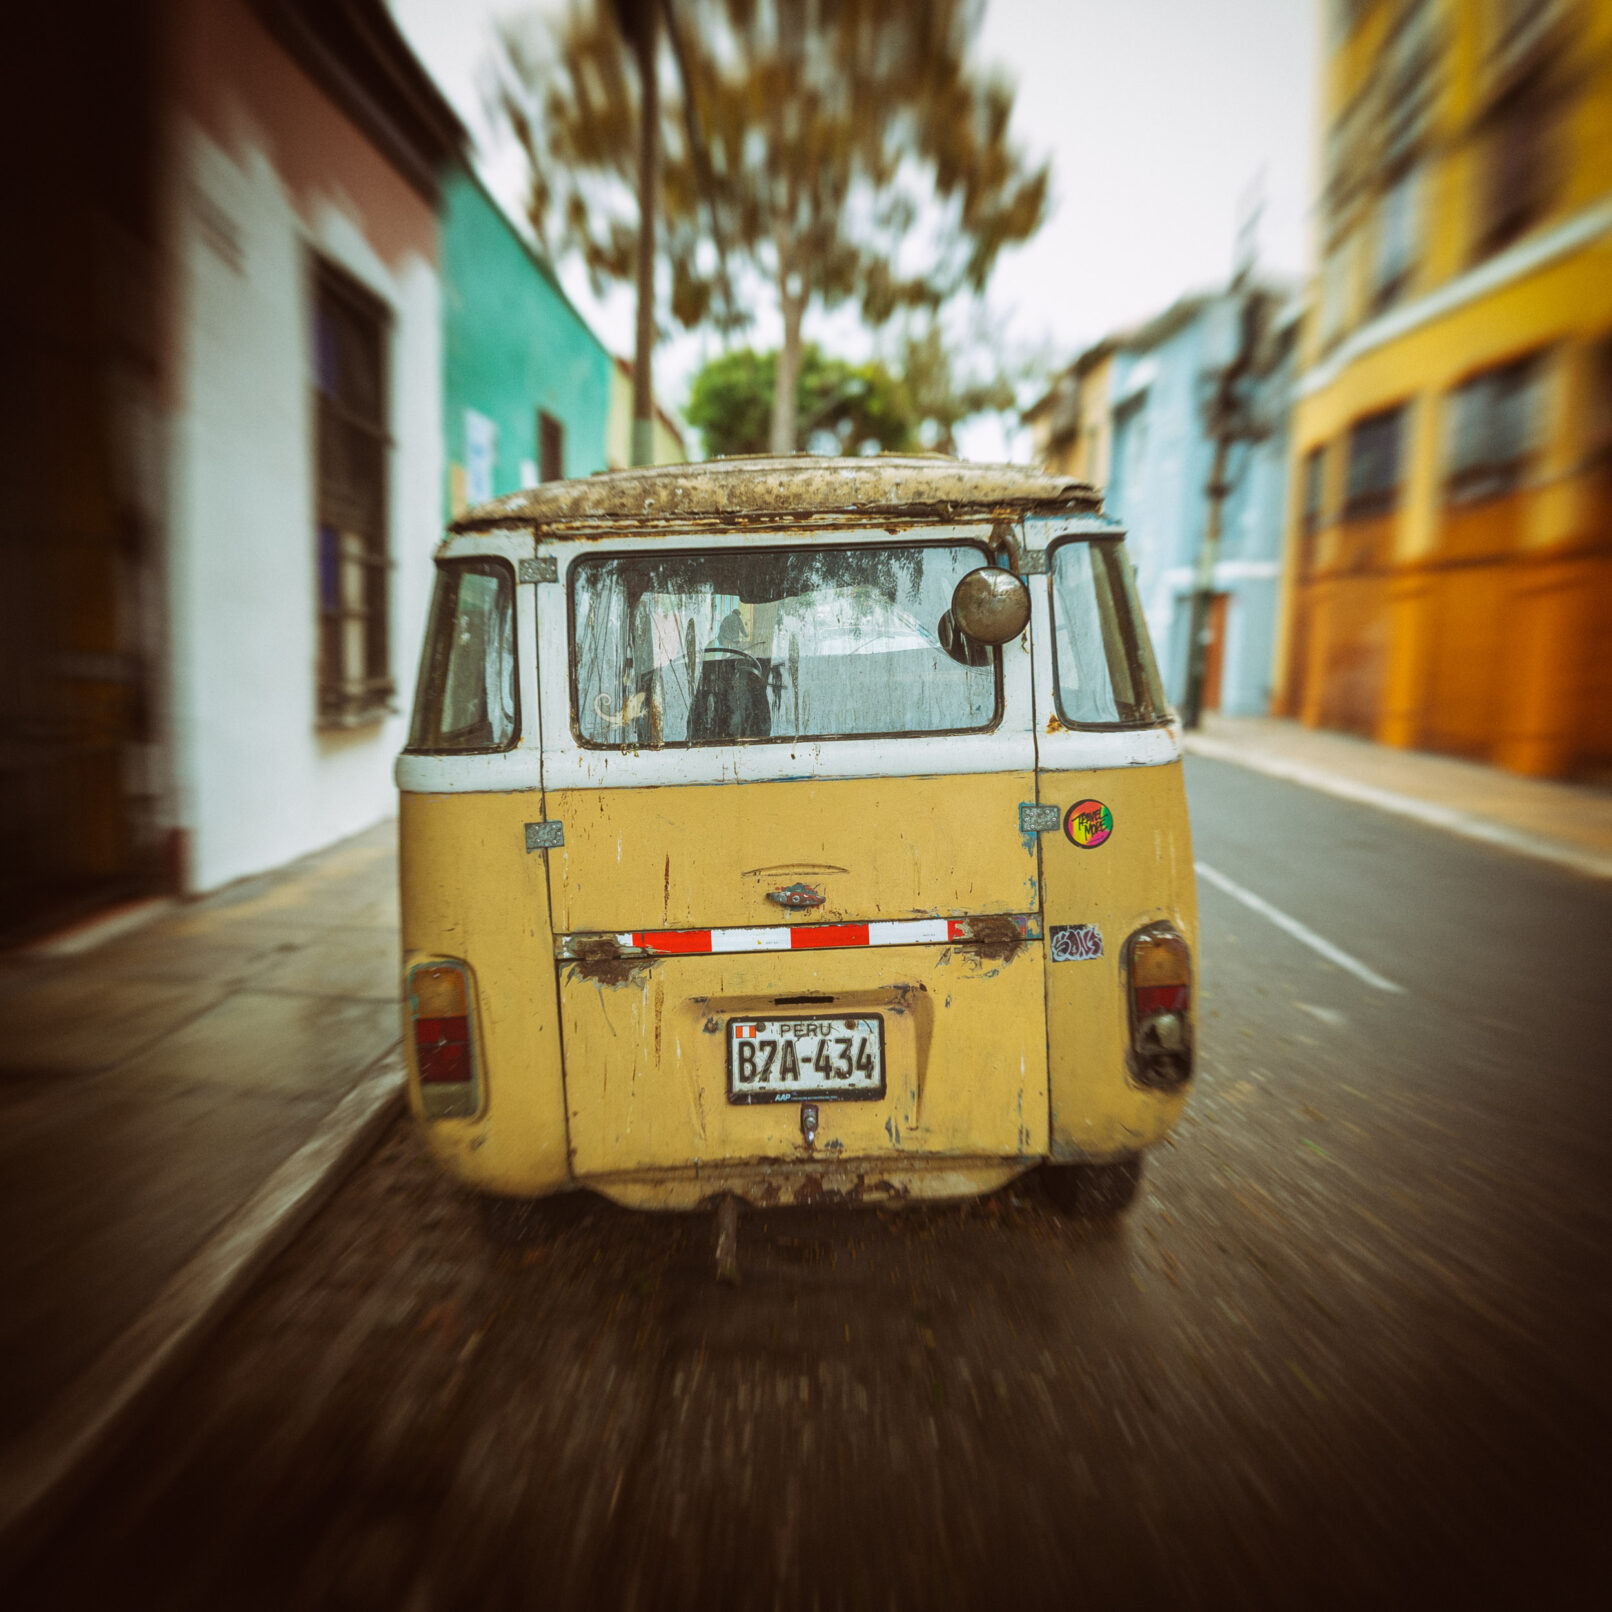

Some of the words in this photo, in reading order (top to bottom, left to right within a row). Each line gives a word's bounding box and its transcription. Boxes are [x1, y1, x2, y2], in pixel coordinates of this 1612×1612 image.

[1084, 819, 1107, 840] MORE
[780, 1023, 832, 1037] PERU
[738, 1038, 874, 1083] B7A-434
[774, 1093, 791, 1102] AAP
